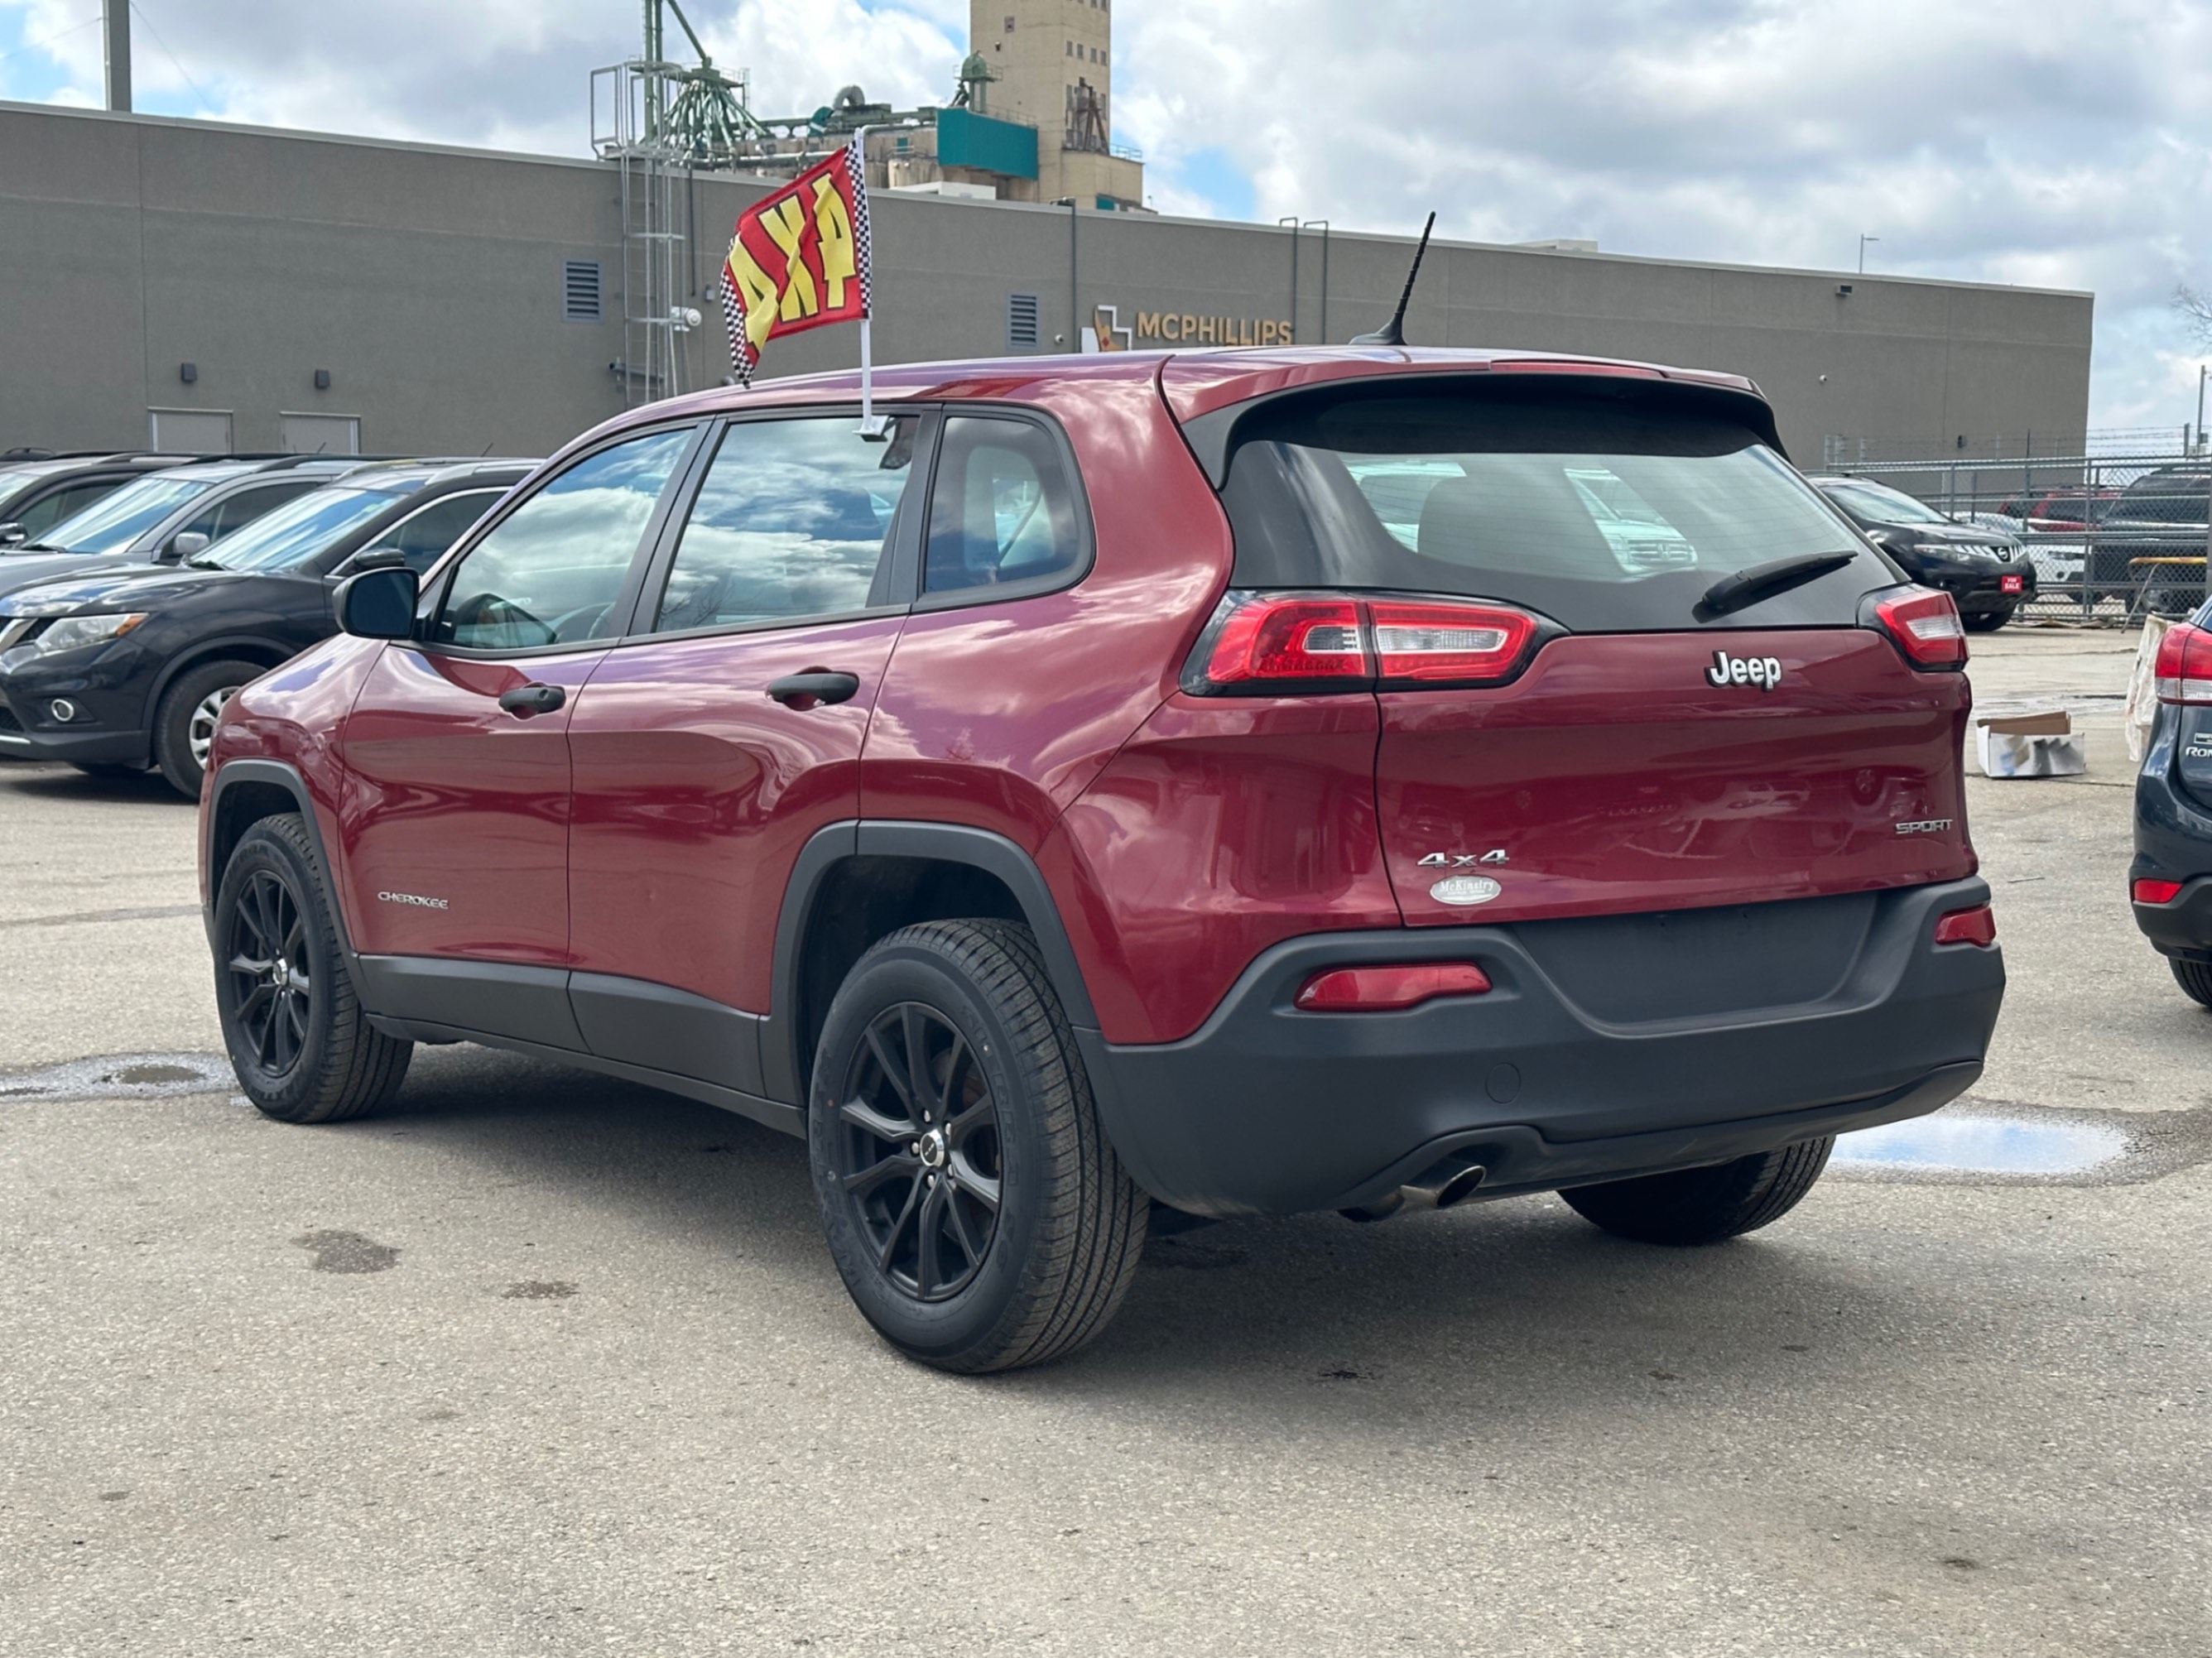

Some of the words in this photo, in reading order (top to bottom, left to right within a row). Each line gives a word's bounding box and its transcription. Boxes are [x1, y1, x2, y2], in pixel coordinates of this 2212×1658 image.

[1137, 311, 1292, 346] MCPHILLIPS
[1705, 650, 1782, 691] Jeep
[1895, 819, 1953, 834] SPORT
[377, 891, 449, 910] CHEROKEE
